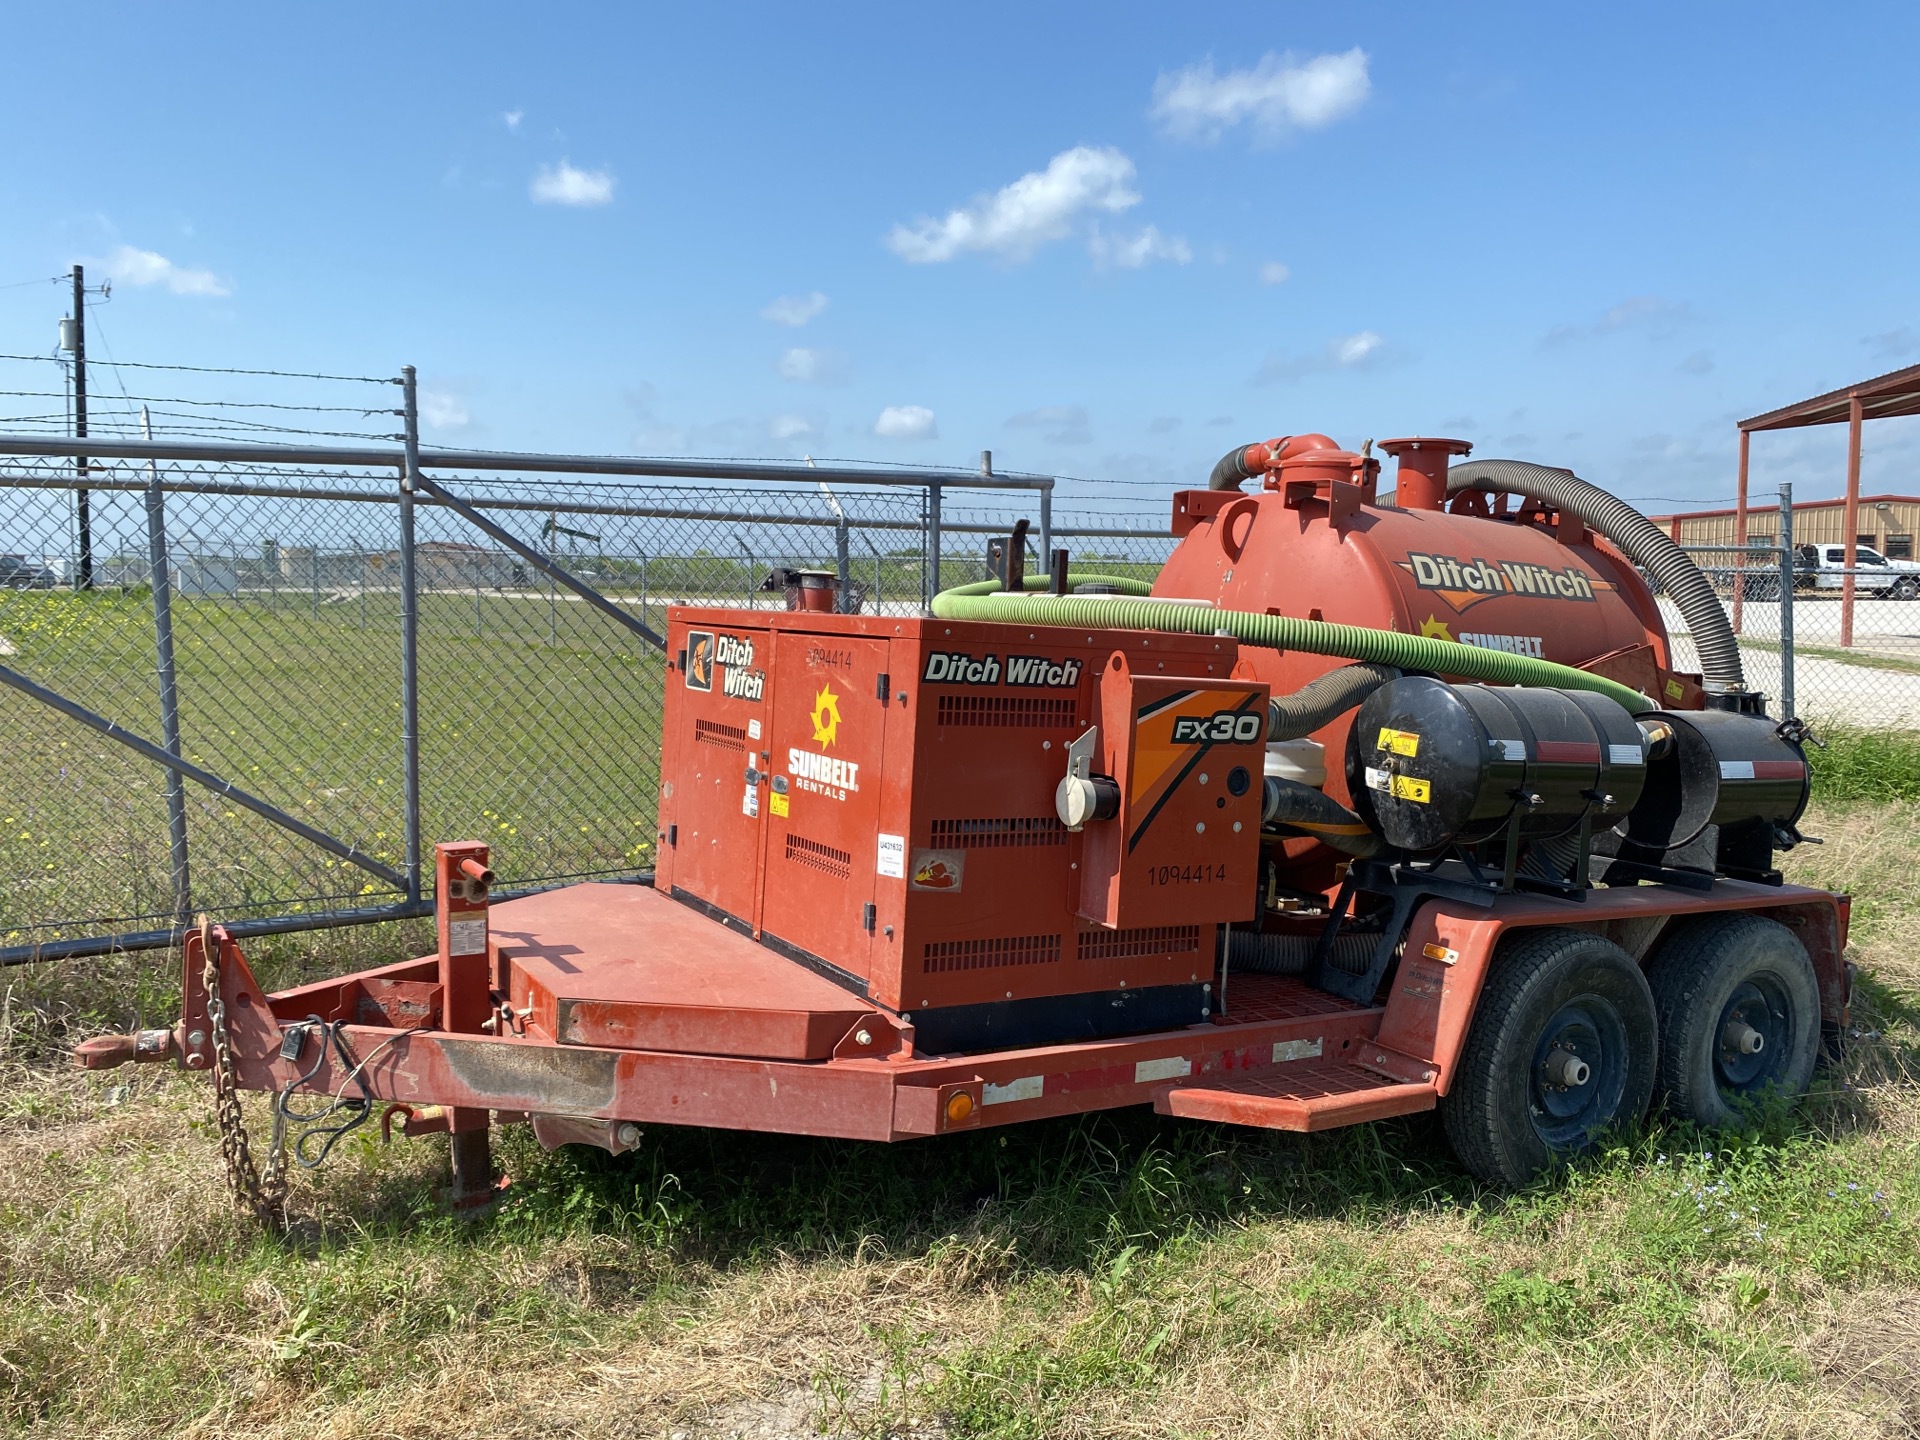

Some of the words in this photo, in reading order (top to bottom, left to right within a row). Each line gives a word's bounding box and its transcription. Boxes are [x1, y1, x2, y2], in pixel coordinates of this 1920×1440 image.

[1411, 555, 1503, 591] Ditch
[1502, 563, 1592, 598] Witch
[716, 636, 753, 666] Ditch
[1459, 632, 1542, 658] SUNBELT
[724, 667, 763, 699] Witch
[925, 654, 1000, 683] Ditch
[1007, 658, 1079, 686] Witch
[1175, 715, 1260, 740] FX30
[788, 748, 858, 790] SUNBELT
[796, 778, 846, 801] RENTALS
[1148, 864, 1226, 886] 1094414
